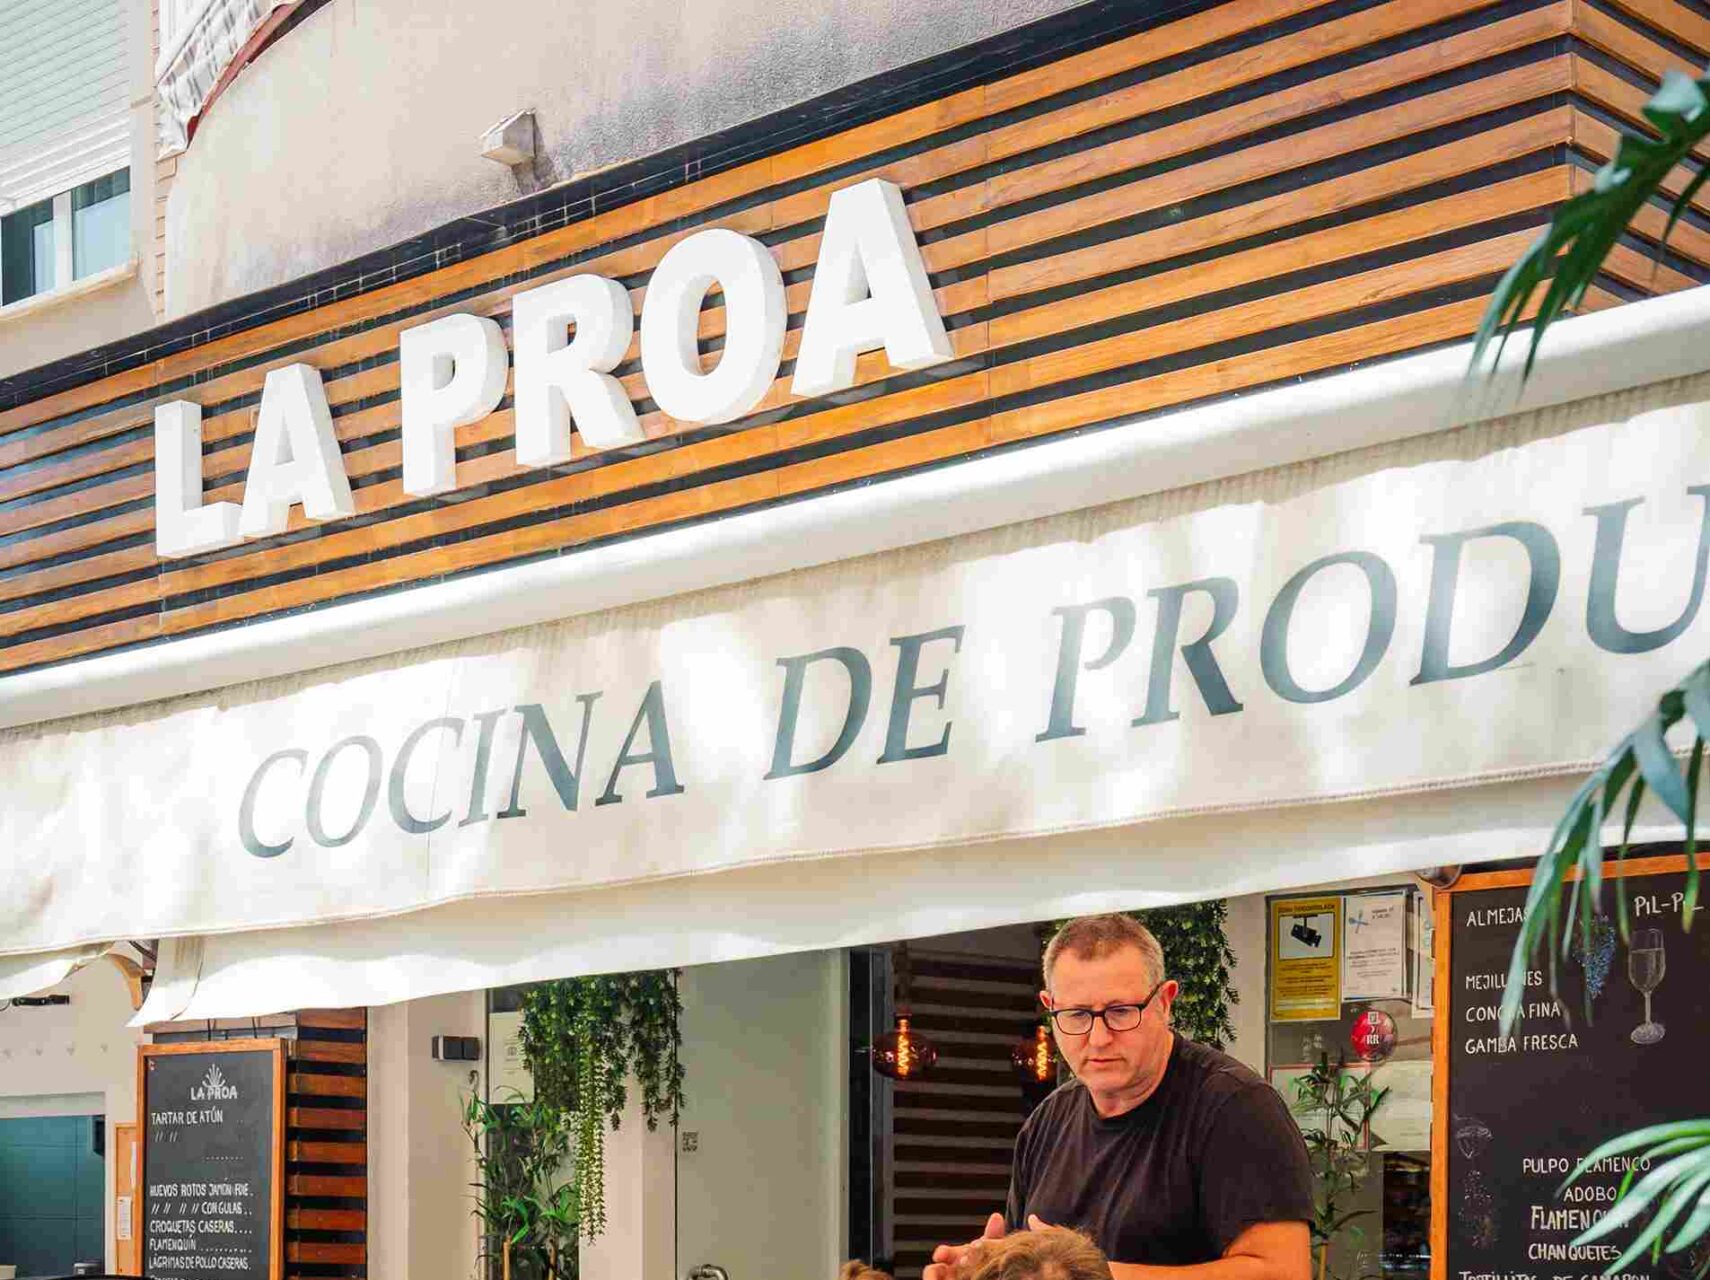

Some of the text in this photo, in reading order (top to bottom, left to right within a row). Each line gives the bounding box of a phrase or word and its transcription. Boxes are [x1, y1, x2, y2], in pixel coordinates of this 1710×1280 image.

[155, 178, 954, 558] LA PROA
[239, 484, 1710, 857] COCINA DE PRODU
[1465, 971, 1542, 990] MEJILLES
[1529, 1002, 1561, 1018] FINA
[1465, 1033, 1579, 1054] GAMBA FRESCA
[191, 1085, 238, 1101] LA PROA
[151, 1106, 223, 1125] TARTAR DE ATÚN
[1523, 1157, 1568, 1174] PULPO
[1563, 1186, 1617, 1203] ADOBO
[201, 1202, 218, 1214] CON
[149, 1220, 196, 1233] CROQUETAS
